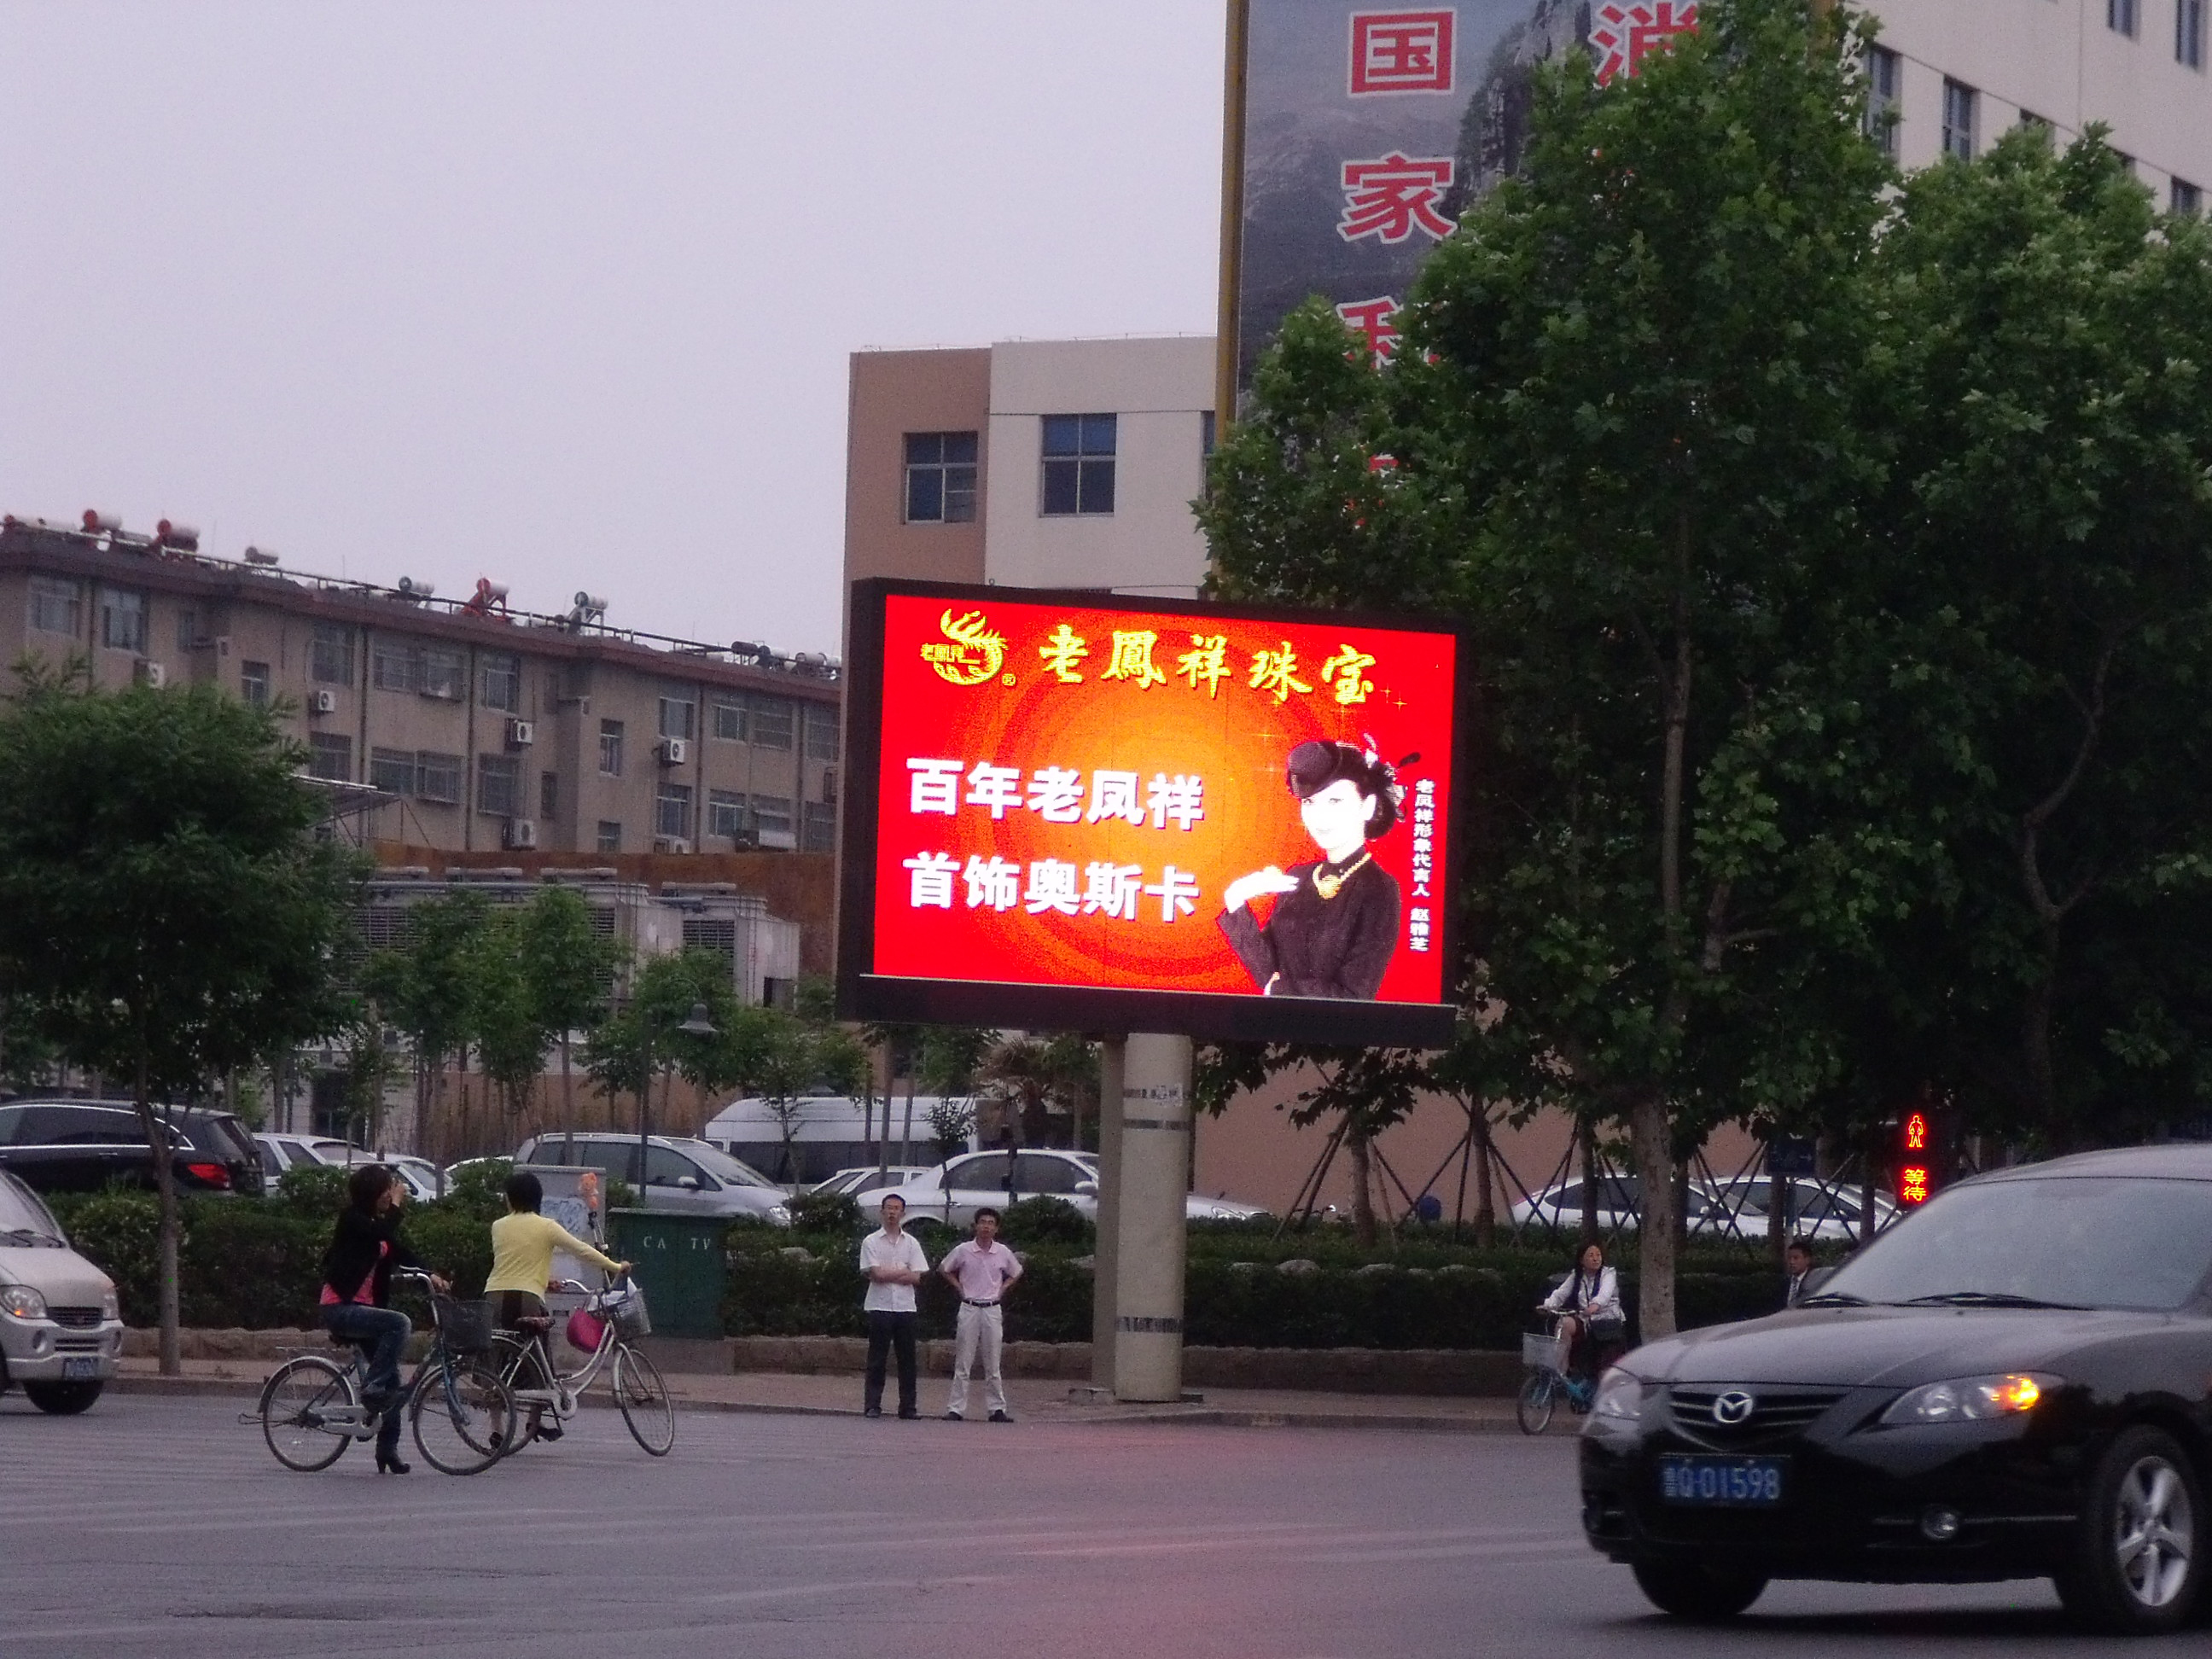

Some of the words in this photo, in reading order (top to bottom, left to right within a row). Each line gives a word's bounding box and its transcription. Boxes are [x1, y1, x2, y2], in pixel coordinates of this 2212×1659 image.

[1038, 624, 1376, 706] 老鳳祥珠宝
[905, 756, 1205, 831] 百年老凤祥
[902, 850, 1200, 923] 首饰奥斯卡
[1902, 1168, 1928, 1202] 等待
[643, 1235, 667, 1249] CA
[690, 1237, 711, 1250] TV
